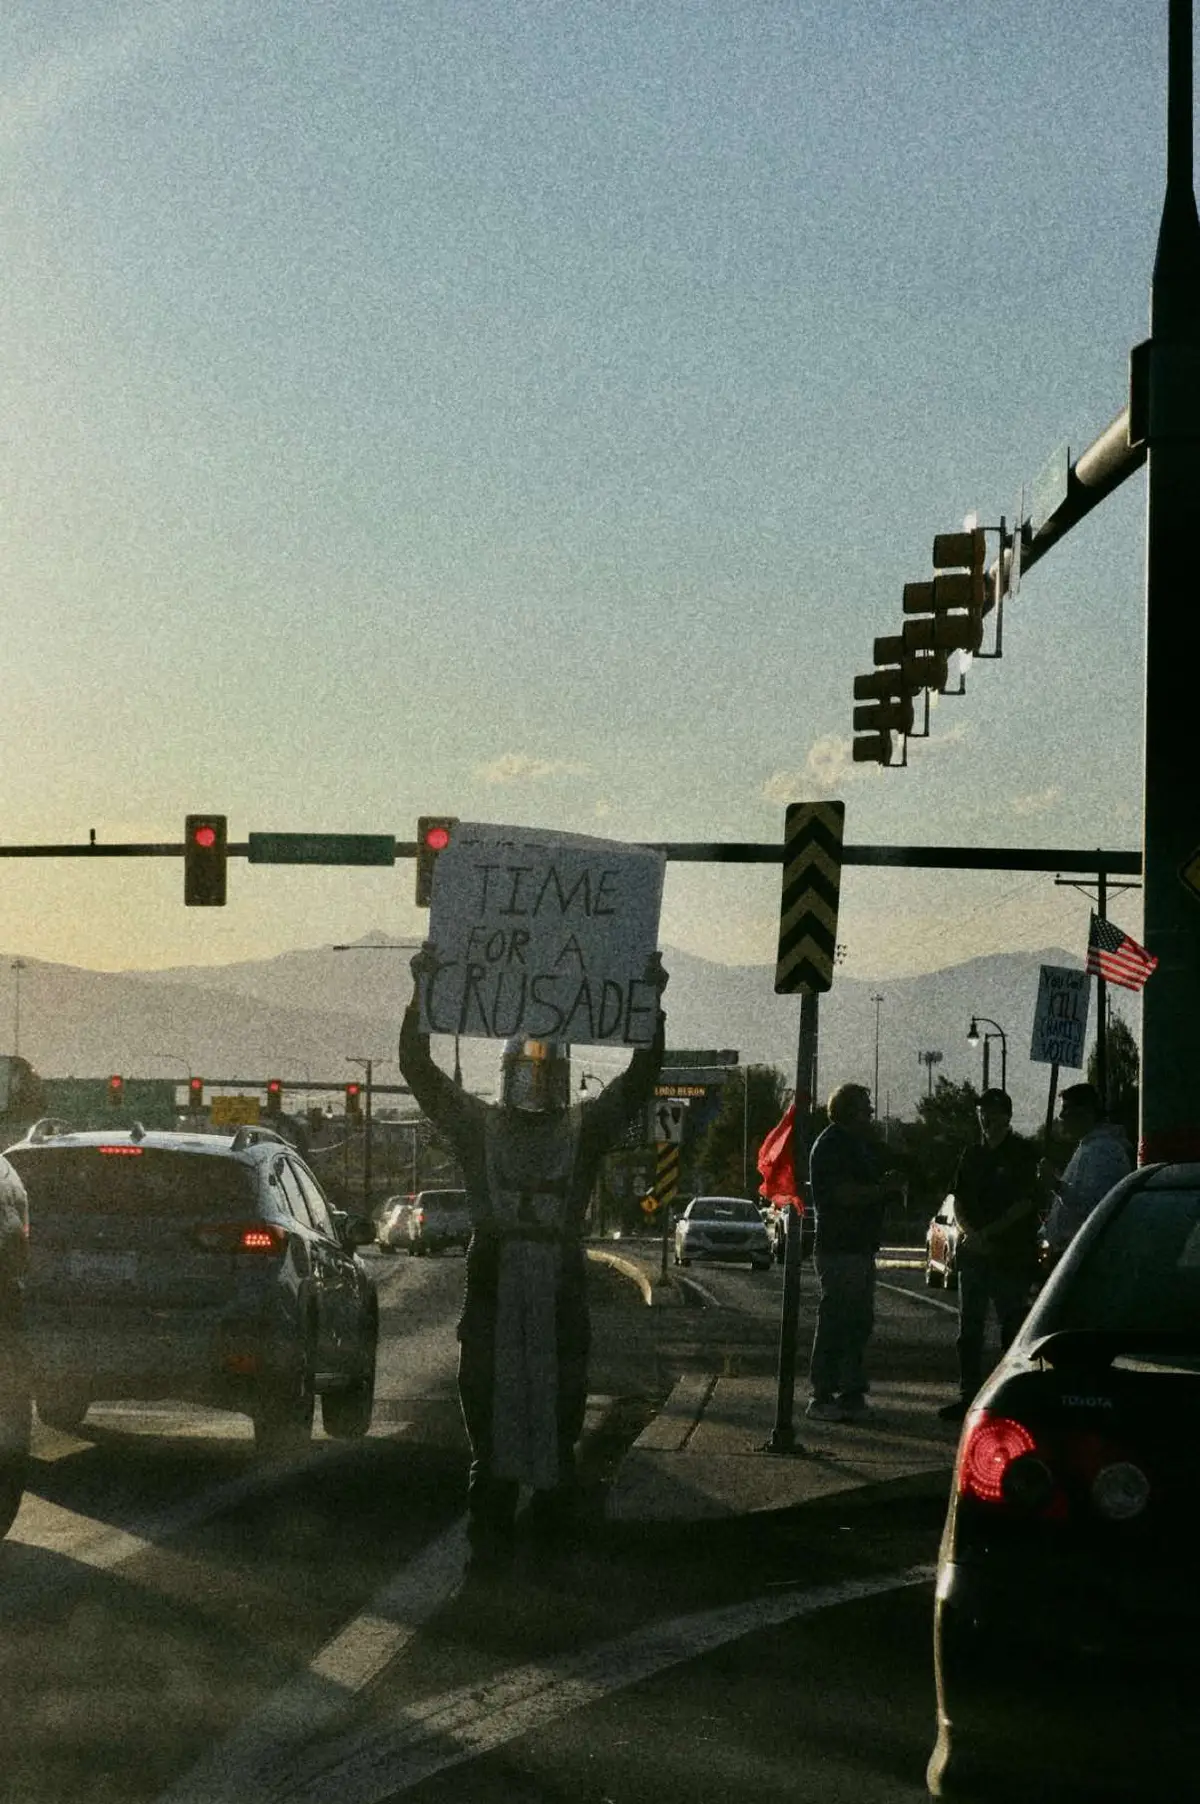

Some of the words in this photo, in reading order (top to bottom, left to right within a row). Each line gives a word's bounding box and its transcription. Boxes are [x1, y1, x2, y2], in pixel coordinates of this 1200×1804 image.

[474, 864, 622, 918] TIME
[465, 926, 530, 966] FOR
[554, 933, 586, 971] A
[425, 960, 654, 1045] CRUSADE
[1043, 1039, 1080, 1067] VOICE
[1060, 1395, 1112, 1409] TOYOTA
